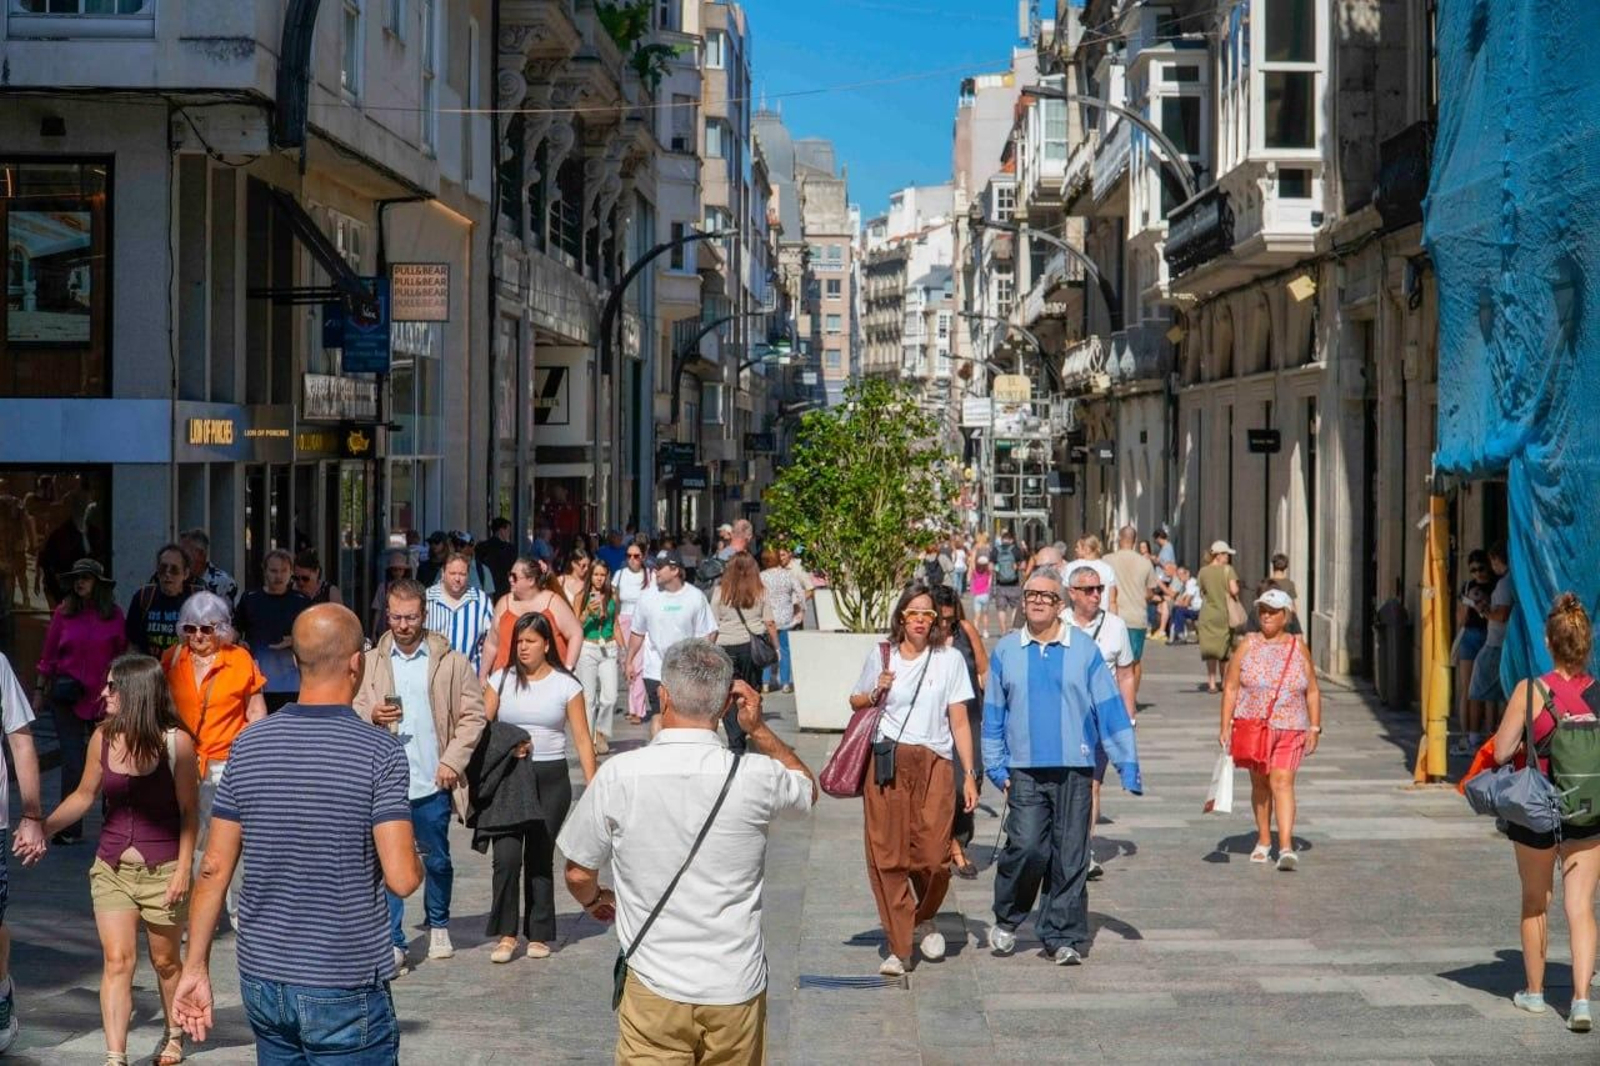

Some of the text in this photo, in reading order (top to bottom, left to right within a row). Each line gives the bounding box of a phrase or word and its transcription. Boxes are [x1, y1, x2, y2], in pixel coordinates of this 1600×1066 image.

[394, 265, 447, 275] PULL&BEAR
[394, 276, 447, 286] PULL&BEAR
[394, 287, 447, 297] PULL&BEAR
[190, 418, 233, 444] LION OF PORCHES
[244, 429, 289, 437] LION OF PORCHES
